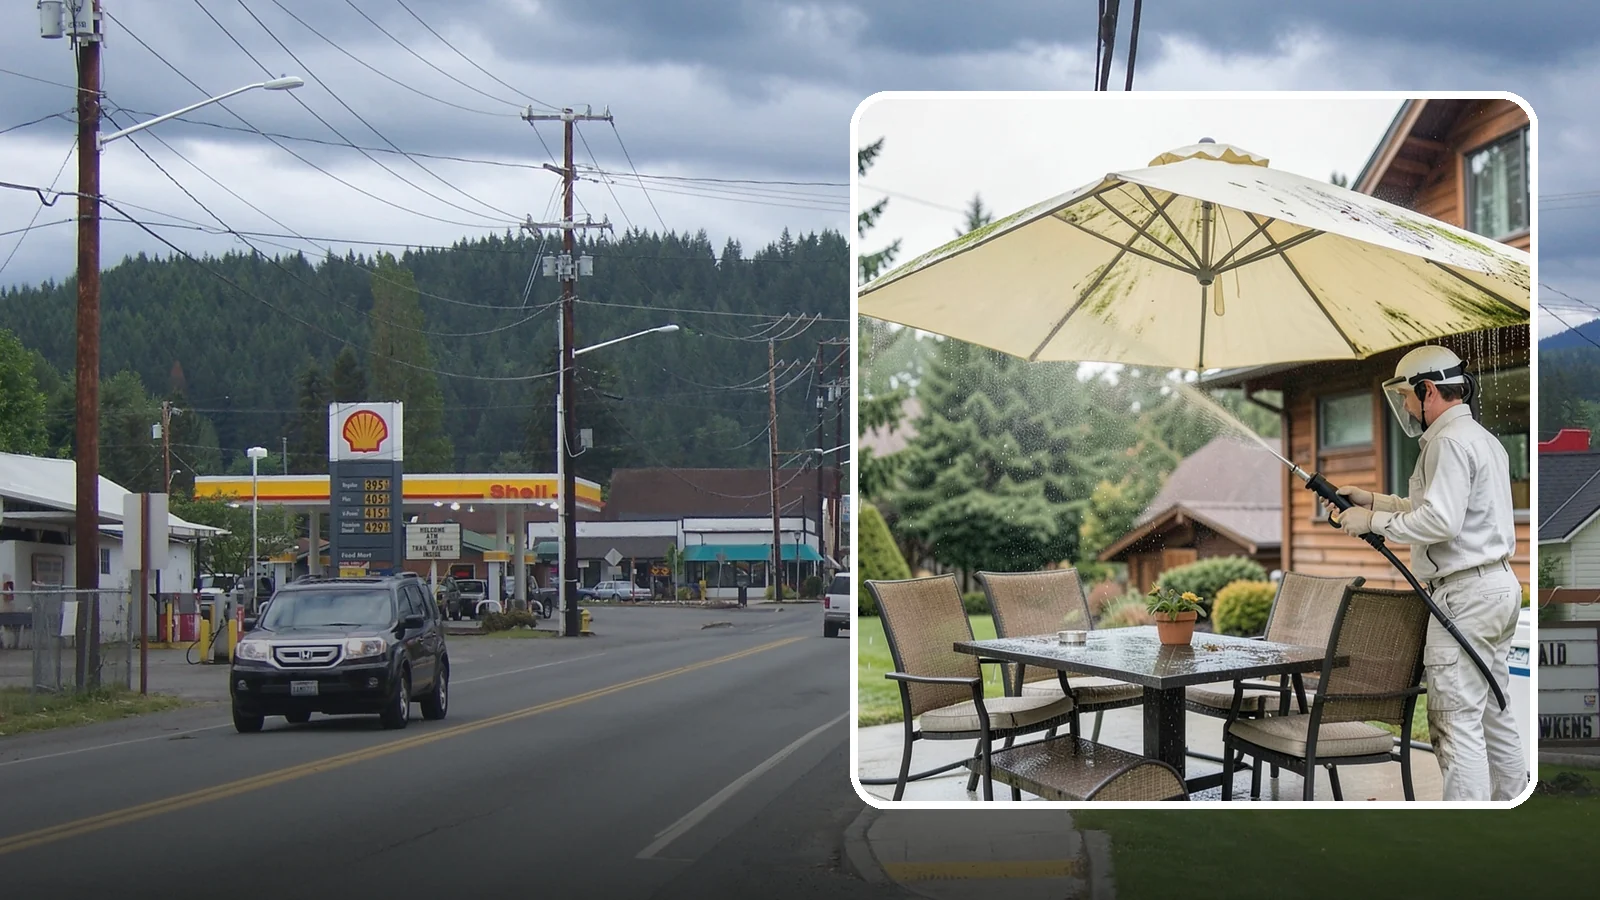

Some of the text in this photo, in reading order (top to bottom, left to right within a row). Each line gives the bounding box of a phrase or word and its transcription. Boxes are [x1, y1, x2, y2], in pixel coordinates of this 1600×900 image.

[366, 480, 383, 490] 395
[490, 484, 547, 499] Shell
[366, 494, 383, 504] 405
[366, 508, 383, 518] 415
[366, 522, 383, 532] 429
